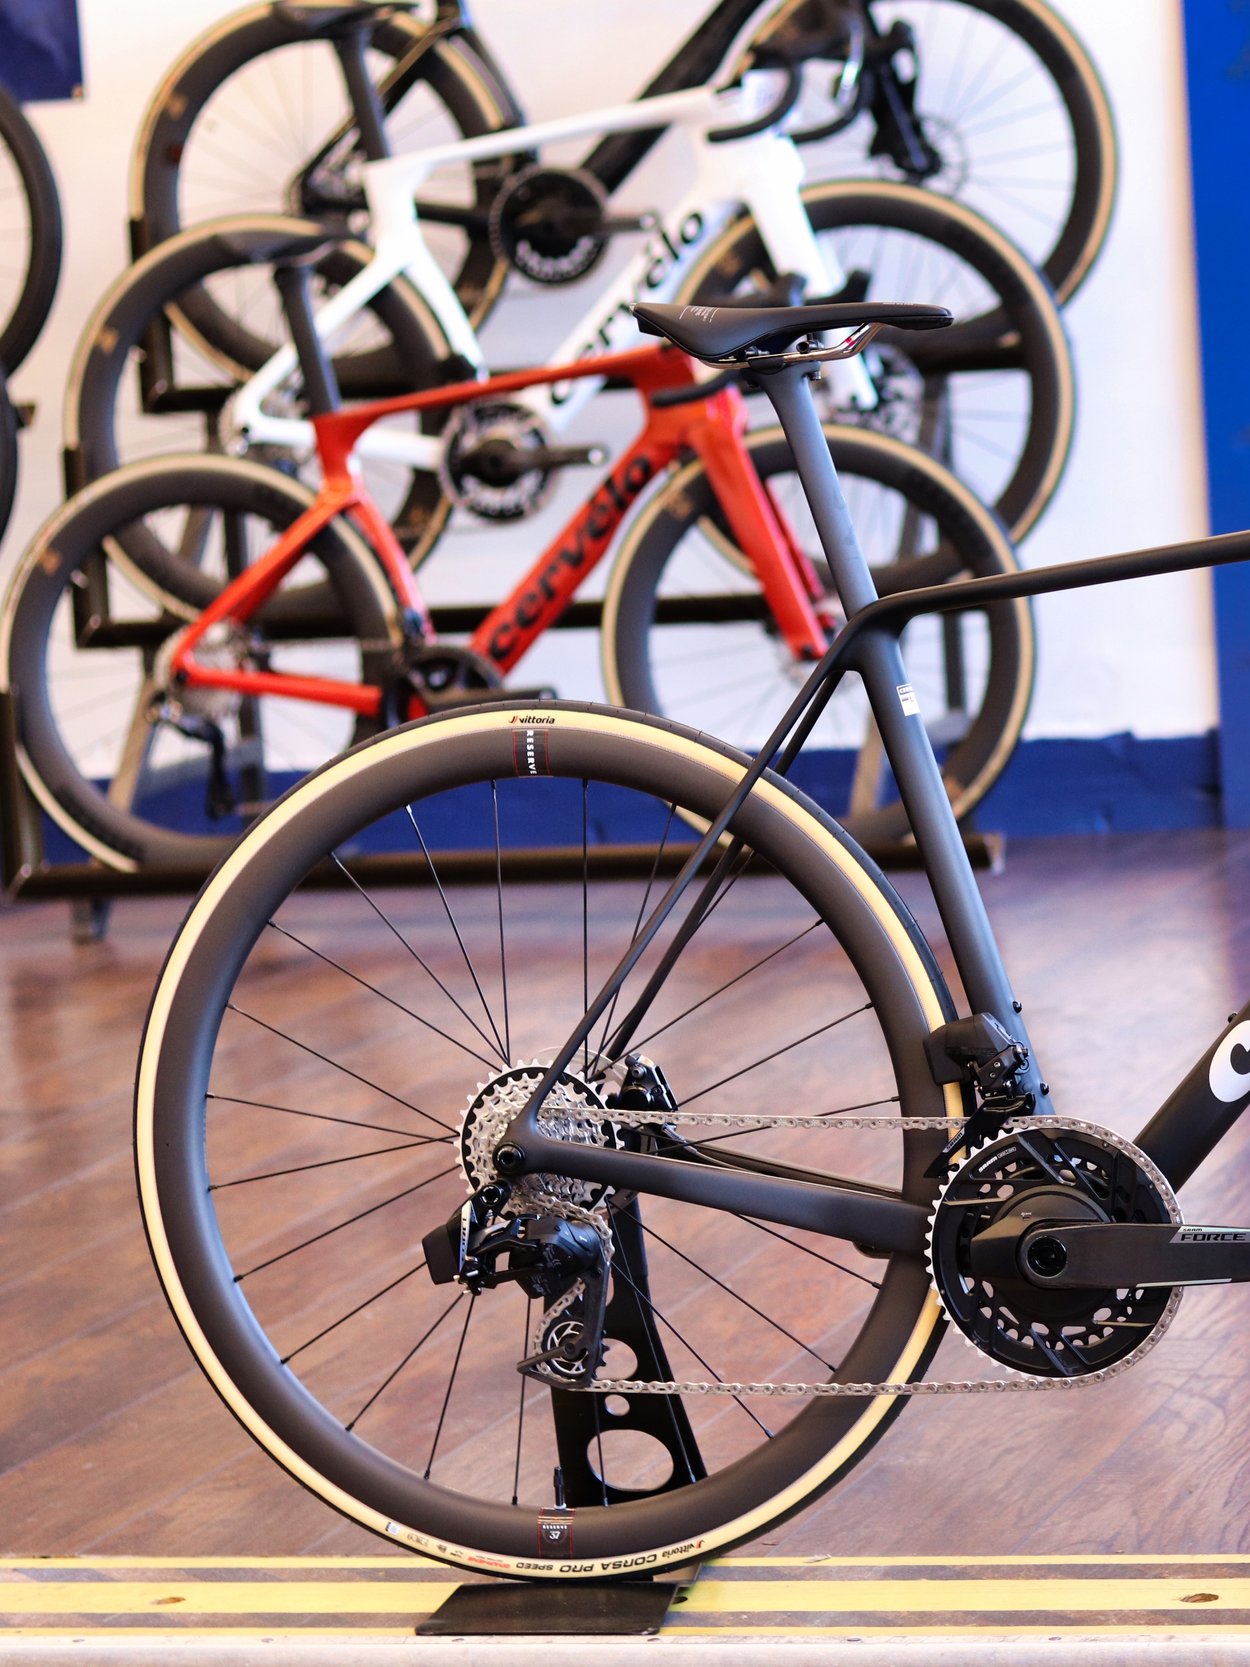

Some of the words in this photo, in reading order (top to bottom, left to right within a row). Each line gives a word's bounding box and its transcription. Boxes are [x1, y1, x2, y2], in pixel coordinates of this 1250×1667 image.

[519, 715, 555, 724] vittoria
[526, 730, 537, 774] RESERVE
[978, 1156, 998, 1173] SRAM
[1180, 1233, 1247, 1242] FORCE
[516, 1562, 553, 1571] SPEED
[601, 1554, 657, 1570] CORSA
[560, 1564, 594, 1573] PRO
